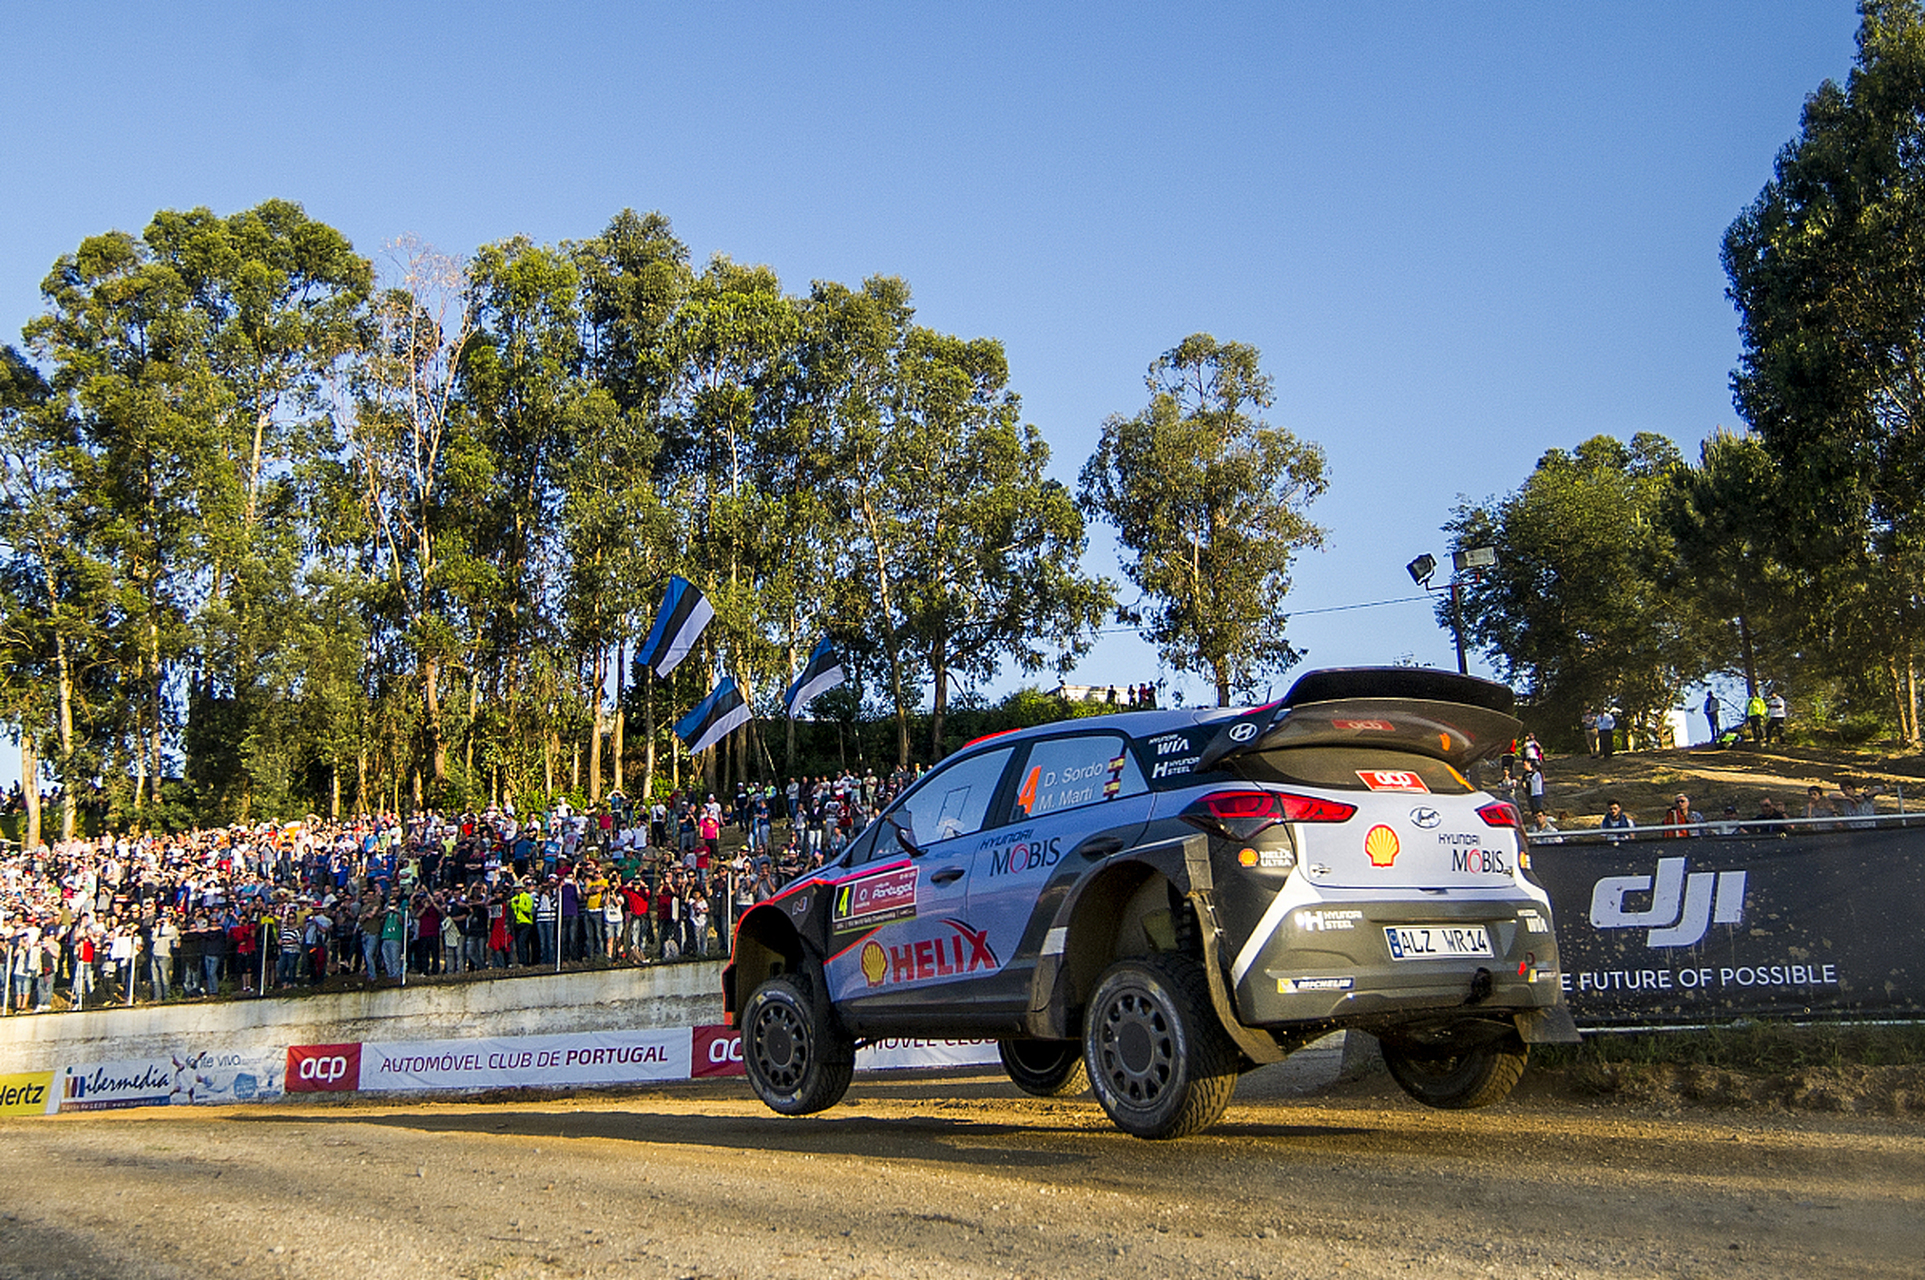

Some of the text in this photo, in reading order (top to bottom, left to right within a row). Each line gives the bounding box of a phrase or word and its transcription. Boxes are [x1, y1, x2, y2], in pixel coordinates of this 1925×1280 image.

[1044, 762, 1104, 788] D. Sordo
[1374, 772, 1412, 787] acp
[1018, 765, 1042, 814] 4
[1038, 783, 1097, 811] M. Martí
[980, 829, 1035, 850] HYUNDAI
[1437, 833, 1481, 846] HYUNDAI
[989, 837, 1061, 877] MOBIS
[1452, 848, 1504, 874] MOBIS
[838, 886, 850, 917] 4
[1324, 920, 1355, 929] STEEL
[1401, 930, 1436, 953] ALZ
[888, 930, 996, 983] HELIX
[1579, 969, 1672, 991] FUTURE
[1678, 967, 1713, 988] OF
[1720, 964, 1838, 985] POSSIBLE
[380, 1046, 669, 1073] AUTOMÓVEL CLUB DE PORTUGAL
[707, 1037, 743, 1063] ac
[85, 1064, 170, 1094] ibermedia
[299, 1055, 348, 1083] acp
